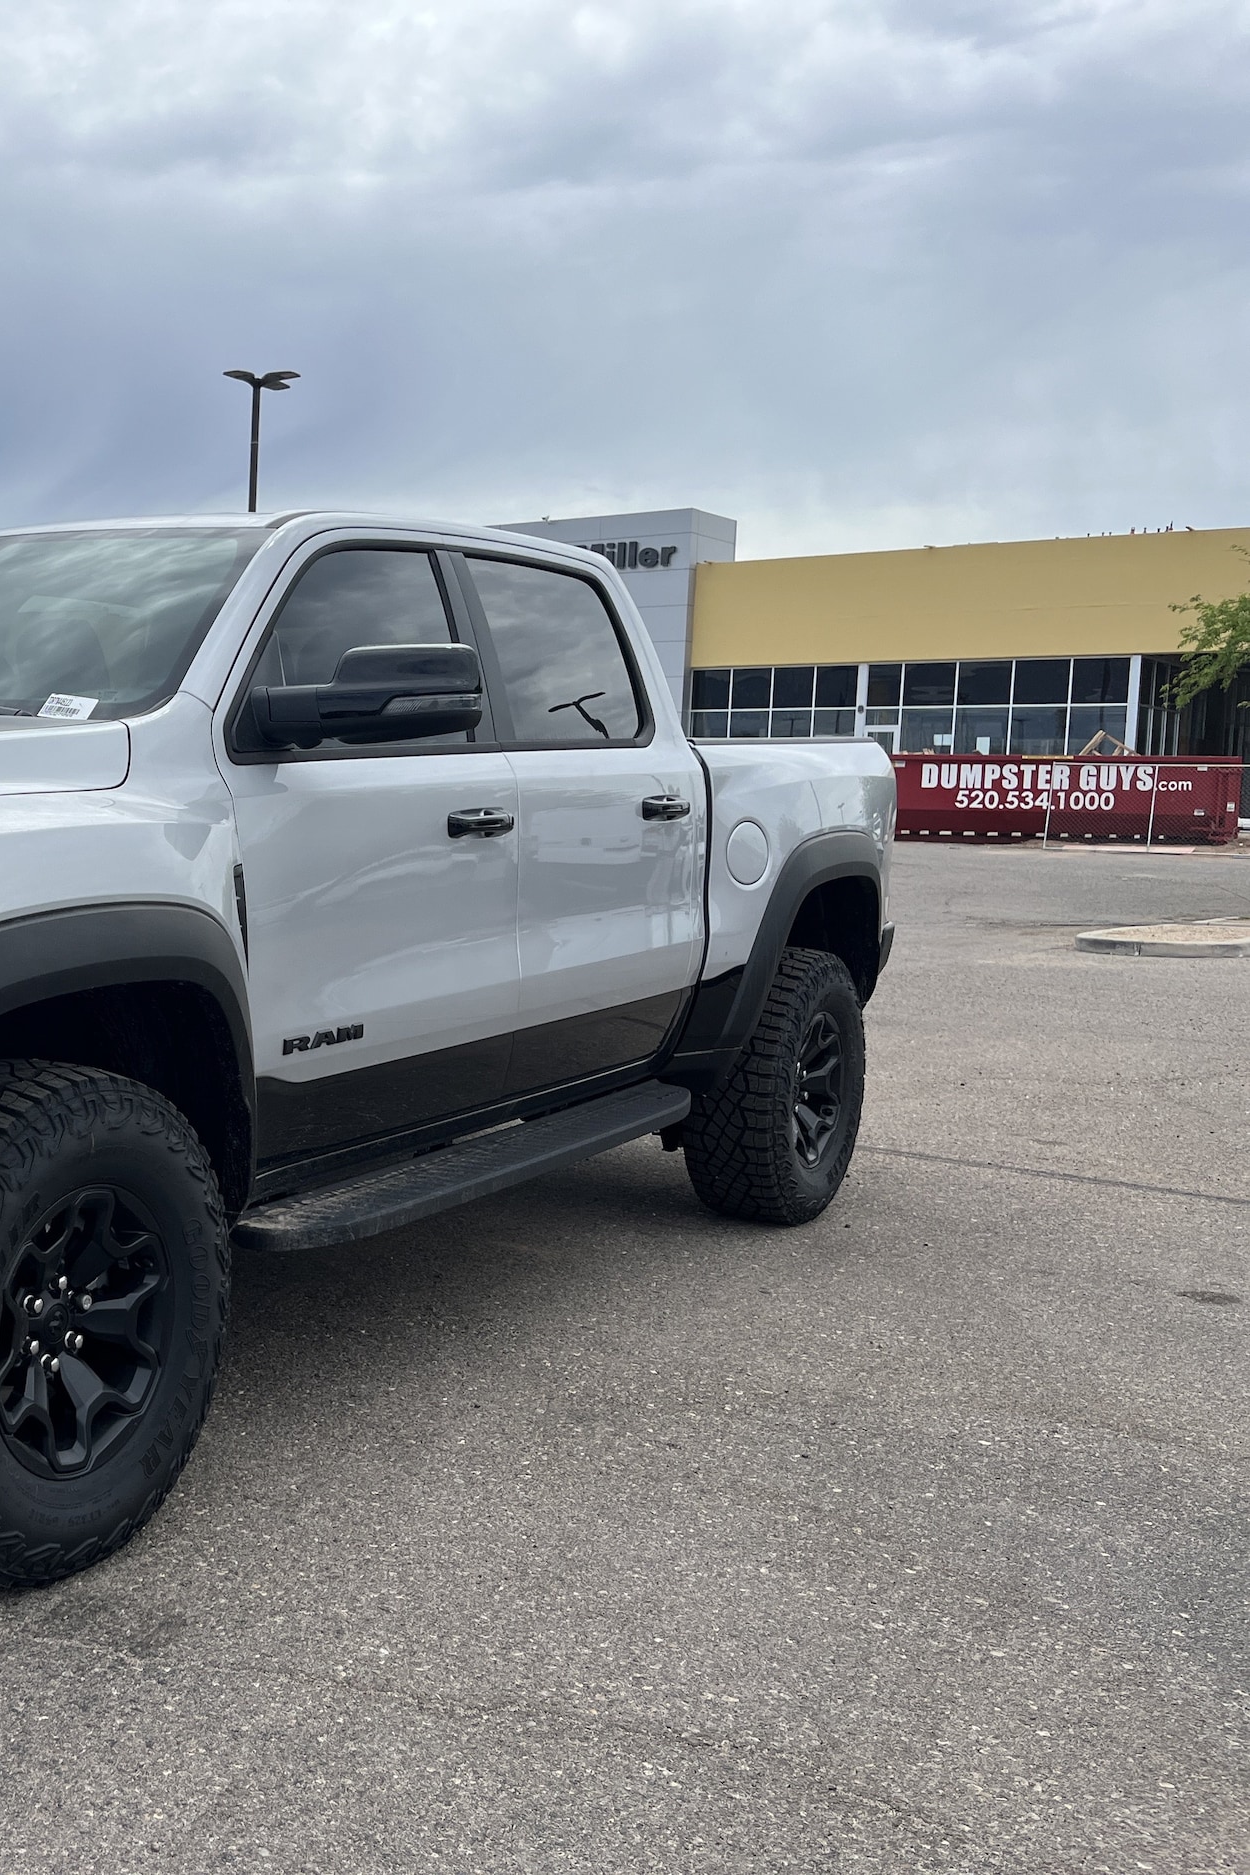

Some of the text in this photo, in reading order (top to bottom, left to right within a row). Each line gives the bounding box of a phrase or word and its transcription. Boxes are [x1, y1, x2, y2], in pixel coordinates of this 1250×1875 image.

[575, 541, 677, 570] iller
[921, 763, 1071, 790] DUMPSTER
[1079, 765, 1154, 791] GUYS
[954, 790, 1115, 810] 520.534.1000
[282, 1022, 364, 1056] RAM
